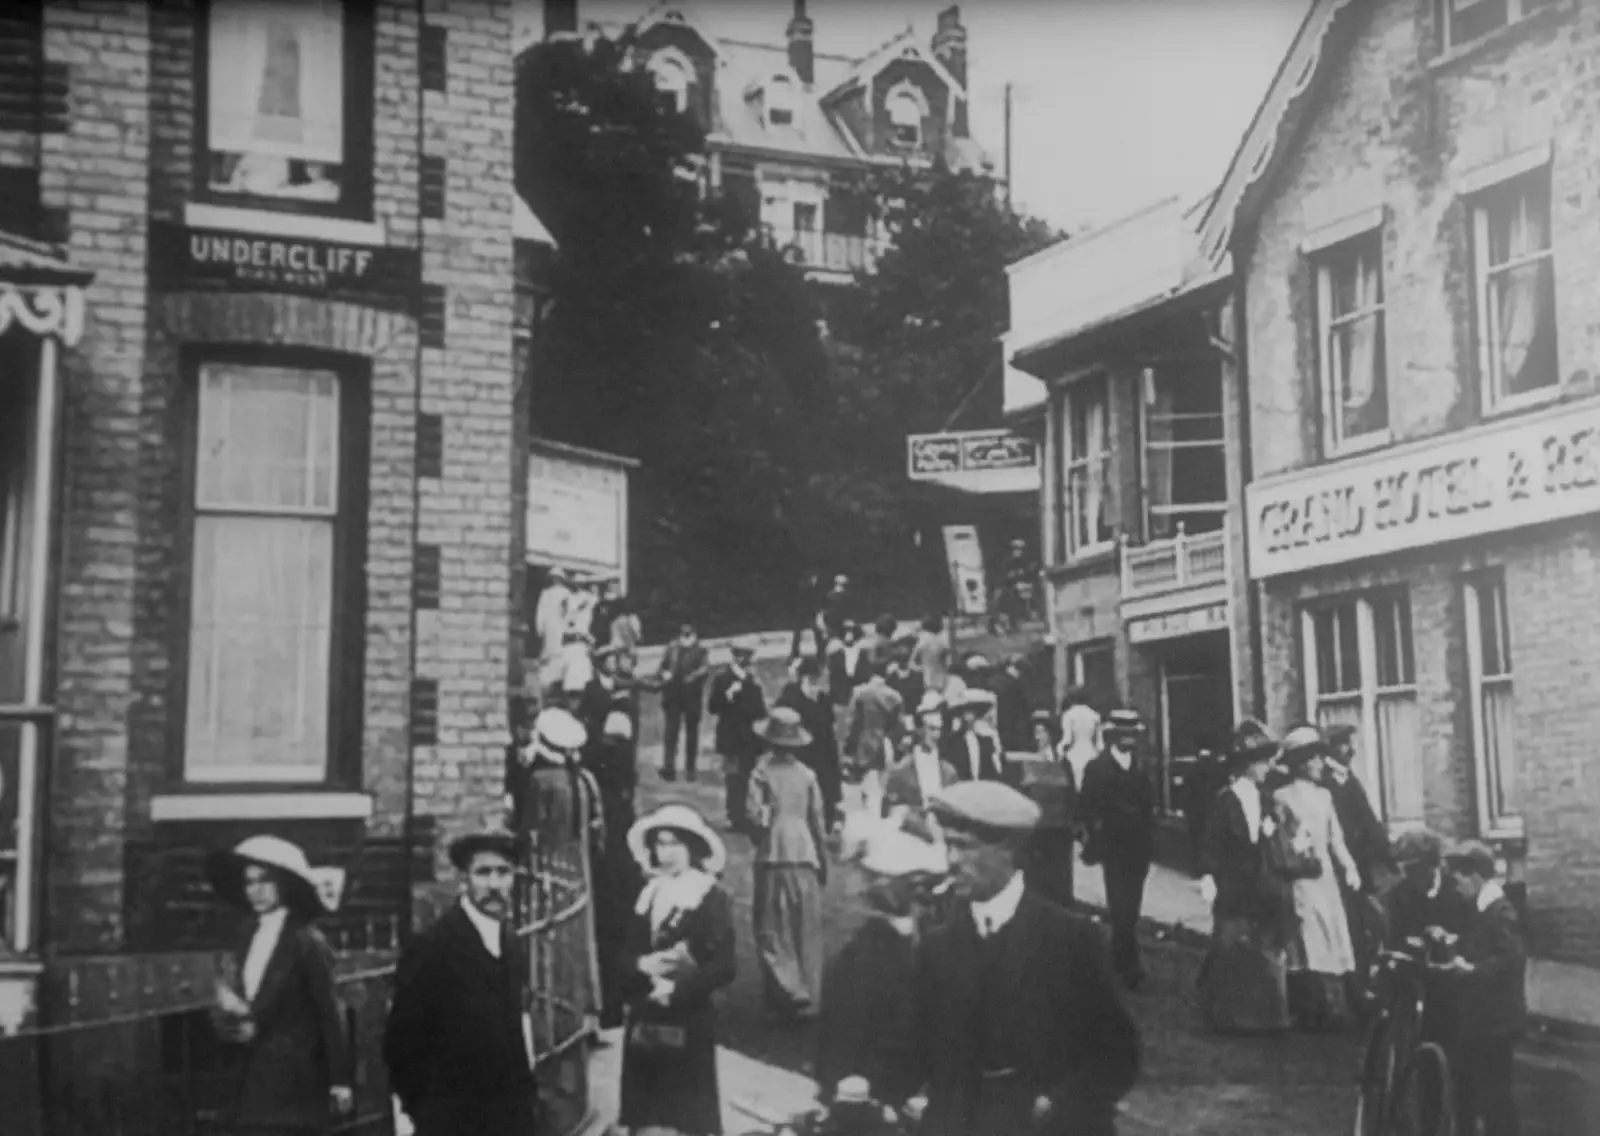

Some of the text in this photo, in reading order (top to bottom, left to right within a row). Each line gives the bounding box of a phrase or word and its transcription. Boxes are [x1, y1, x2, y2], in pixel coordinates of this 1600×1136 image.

[190, 235, 373, 276] UNDERCLIFF
[1259, 426, 1599, 554] GRAND HOTEL & RE
